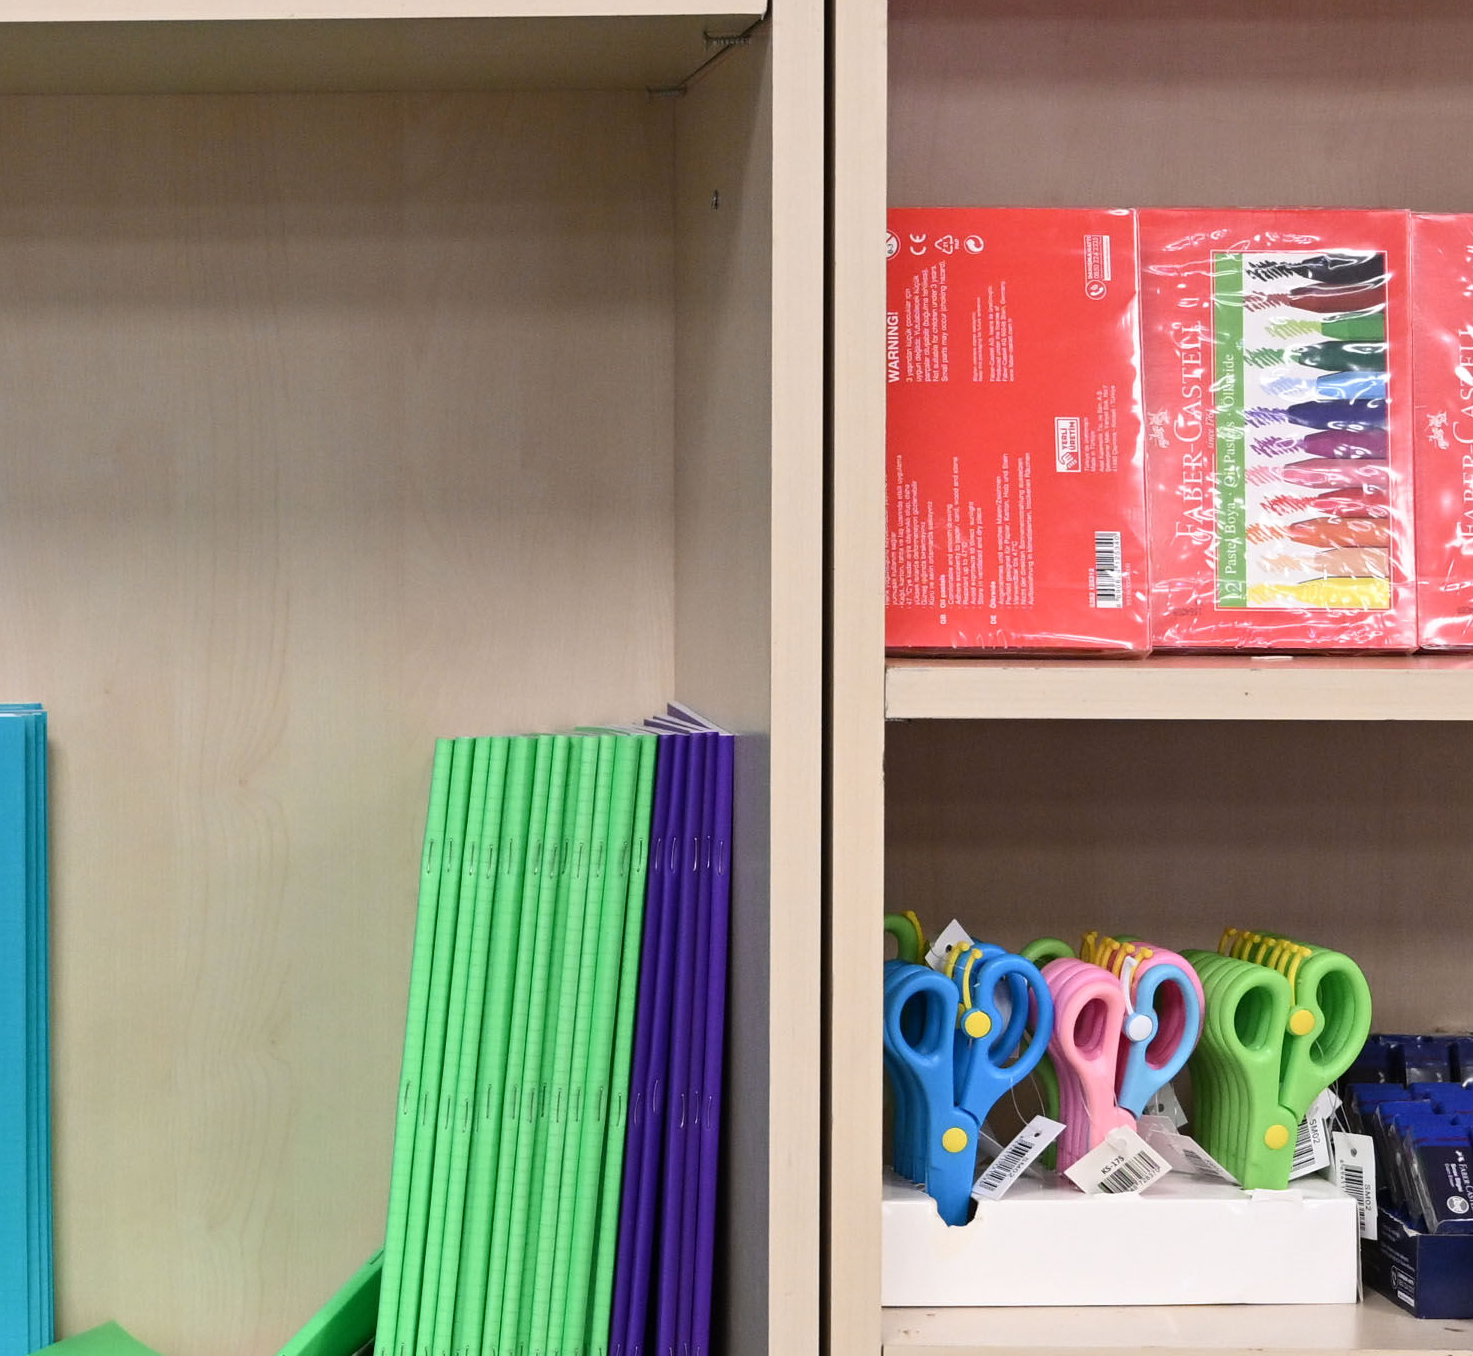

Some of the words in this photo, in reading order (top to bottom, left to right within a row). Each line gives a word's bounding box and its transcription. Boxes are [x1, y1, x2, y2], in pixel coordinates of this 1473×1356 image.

[887, 312, 899, 382] WARNING!
[1172, 321, 1203, 538] FABER-CASTELL
[1310, 1119, 1321, 1144] SM02
[1100, 1154, 1125, 1175] KS-175
[1362, 1184, 1371, 1211] SM02
